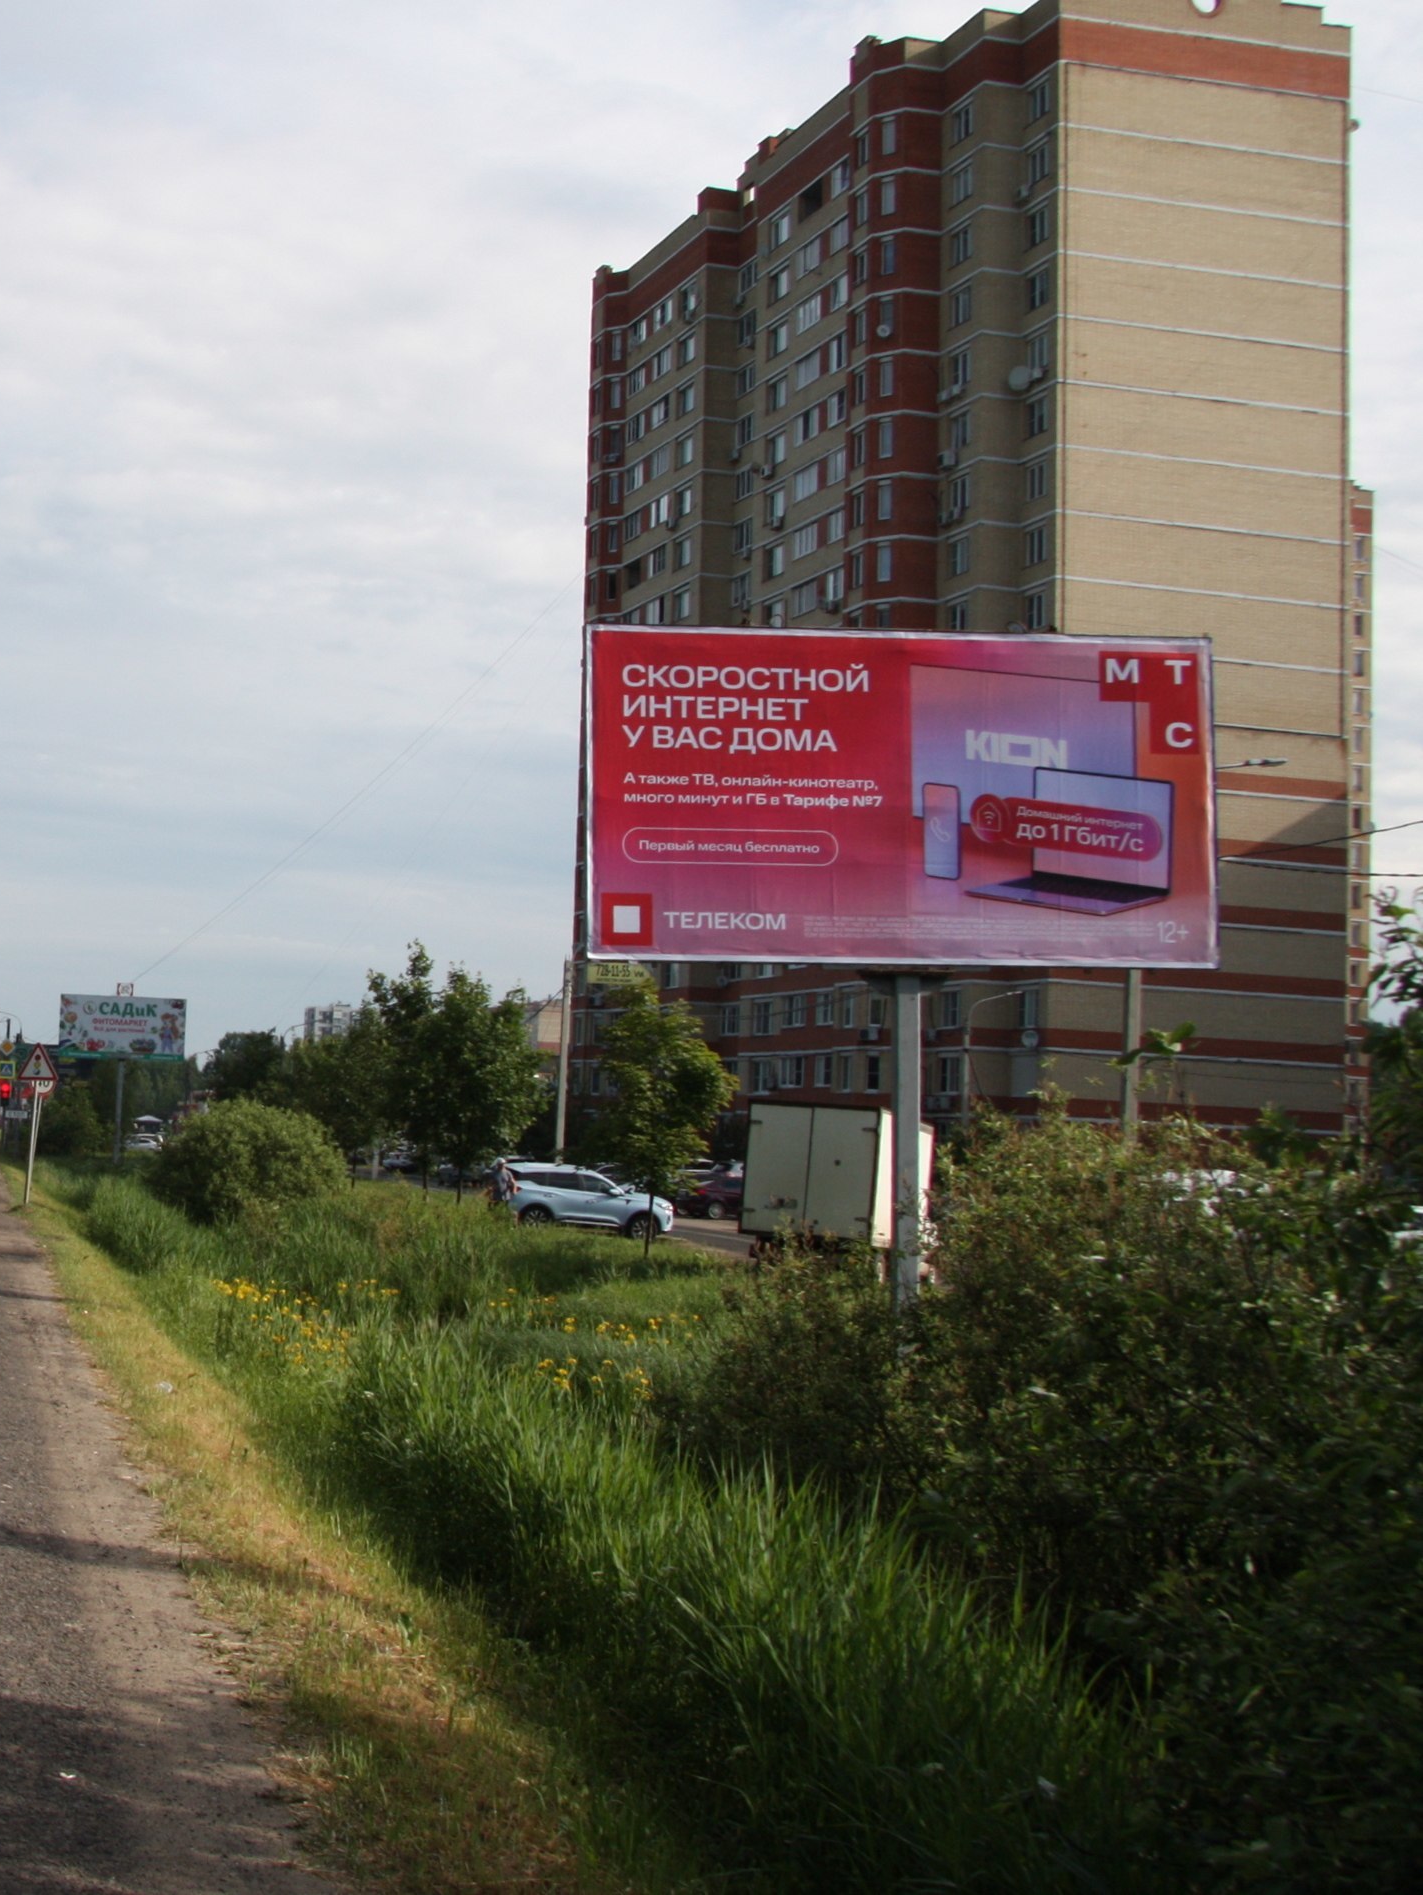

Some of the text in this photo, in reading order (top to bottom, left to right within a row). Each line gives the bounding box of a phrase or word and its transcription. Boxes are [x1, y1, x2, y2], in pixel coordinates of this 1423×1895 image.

[622, 663, 870, 693] СКОРОСТНОЙ
[622, 694, 809, 721] ИНТЕРНЕТ
[621, 724, 838, 755] У ВАС ДОМА
[965, 729, 1068, 769] KION
[623, 772, 879, 791] А также ТВ, онлайн-кинотеатр,
[624, 792, 883, 809] много минут и ГБ в Тарифе №7
[1016, 806, 1144, 831] Домашний интернет
[639, 839, 820, 854] Первый месяц бесплатно
[1016, 823, 1144, 852] до 1 Гбит/с
[663, 911, 786, 930] ТЕЛЕКОМ
[1156, 920, 1189, 944] 12+
